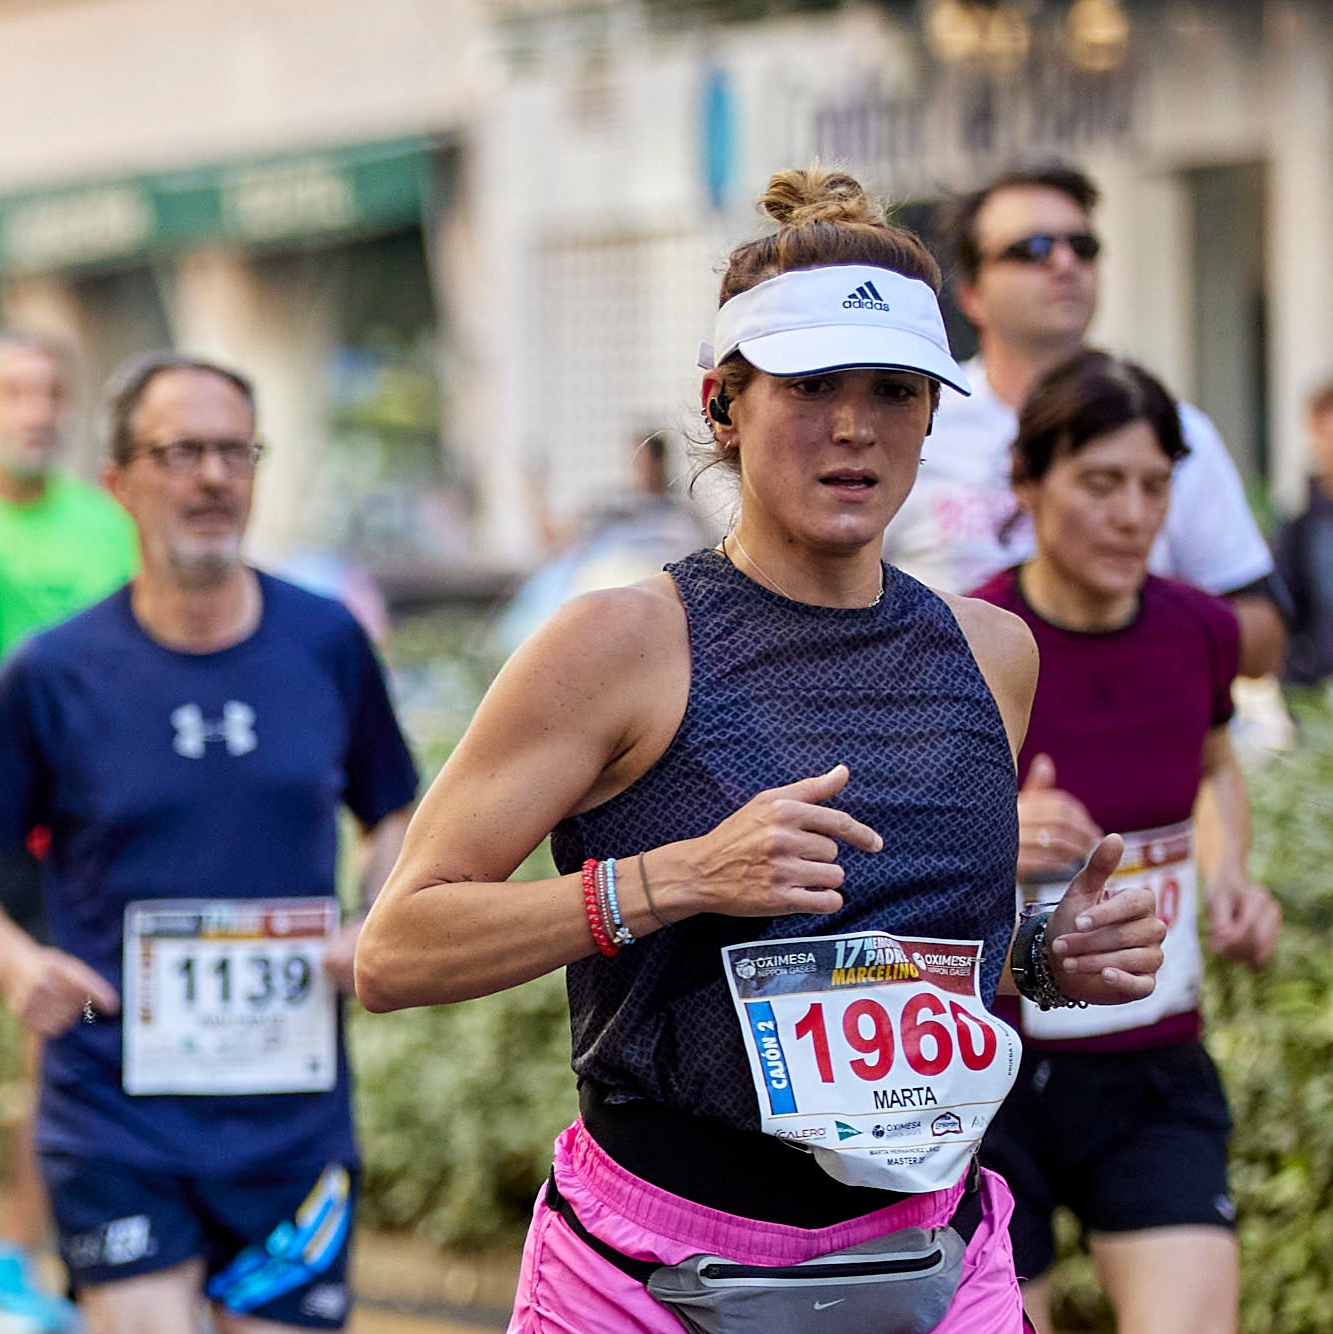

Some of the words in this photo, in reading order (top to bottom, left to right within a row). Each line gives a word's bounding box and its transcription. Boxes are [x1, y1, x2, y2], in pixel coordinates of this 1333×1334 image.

[842, 298, 890, 312] adidas
[756, 952, 817, 968] OXIMESA
[835, 939, 865, 969] 17
[925, 954, 972, 967] OXIMESA
[789, 964, 817, 975] GASES
[831, 963, 919, 986] MARCELINO
[173, 953, 312, 1007] 1139
[757, 1020, 775, 1032] 2
[794, 991, 997, 1084] 1960
[761, 1037, 788, 1090] CAJÓN
[873, 1086, 938, 1109] MARTA
[778, 1127, 827, 1139] CALERO
[886, 1121, 921, 1132] OXIMESA
[887, 1156, 917, 1166] MASTER
